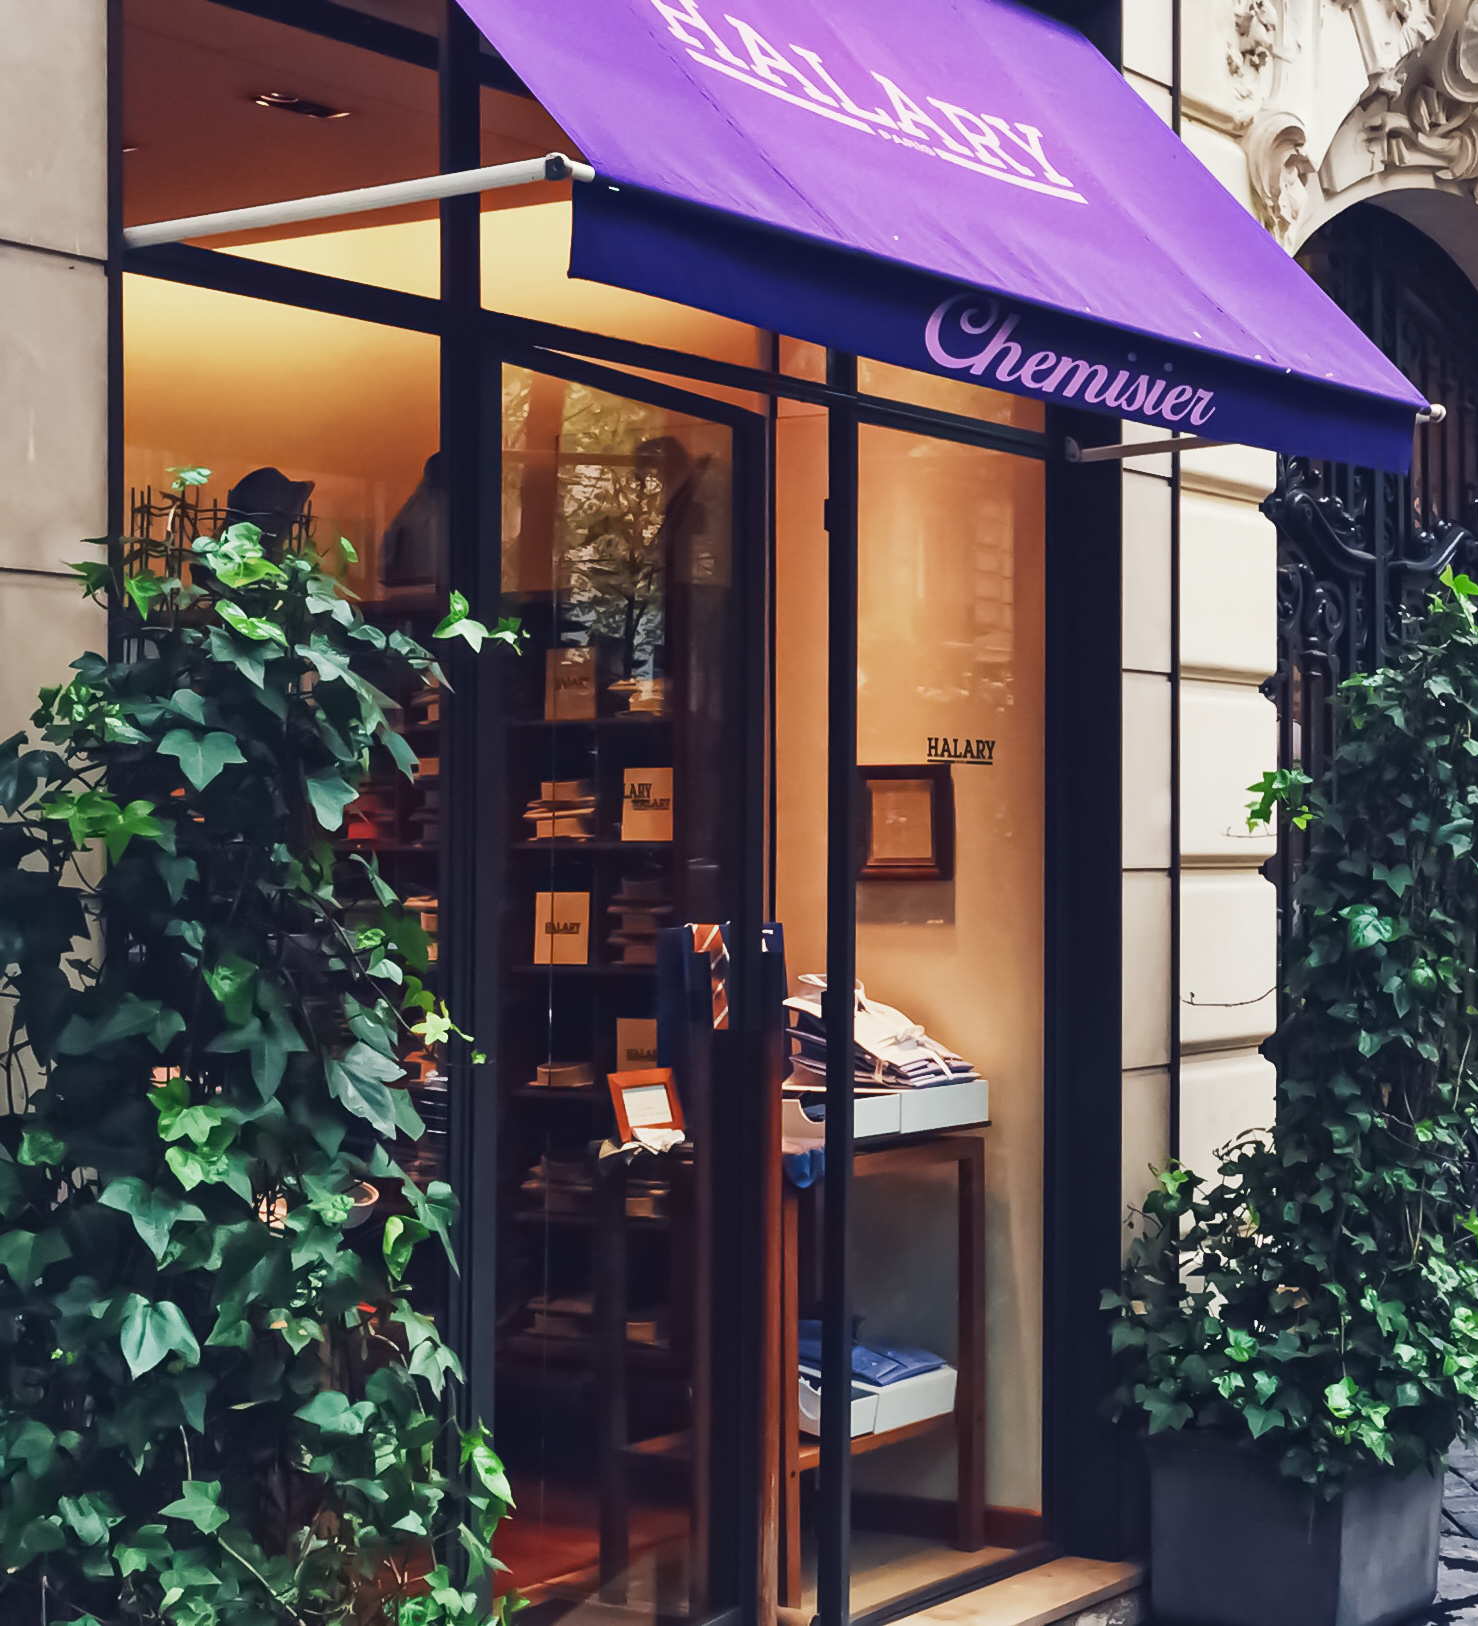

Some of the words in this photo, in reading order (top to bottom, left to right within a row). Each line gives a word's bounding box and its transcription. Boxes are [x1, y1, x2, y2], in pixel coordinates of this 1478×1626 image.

[650, 0, 1074, 187] HALARY
[925, 292, 1215, 425] Chemisier
[927, 737, 996, 760] HALARY
